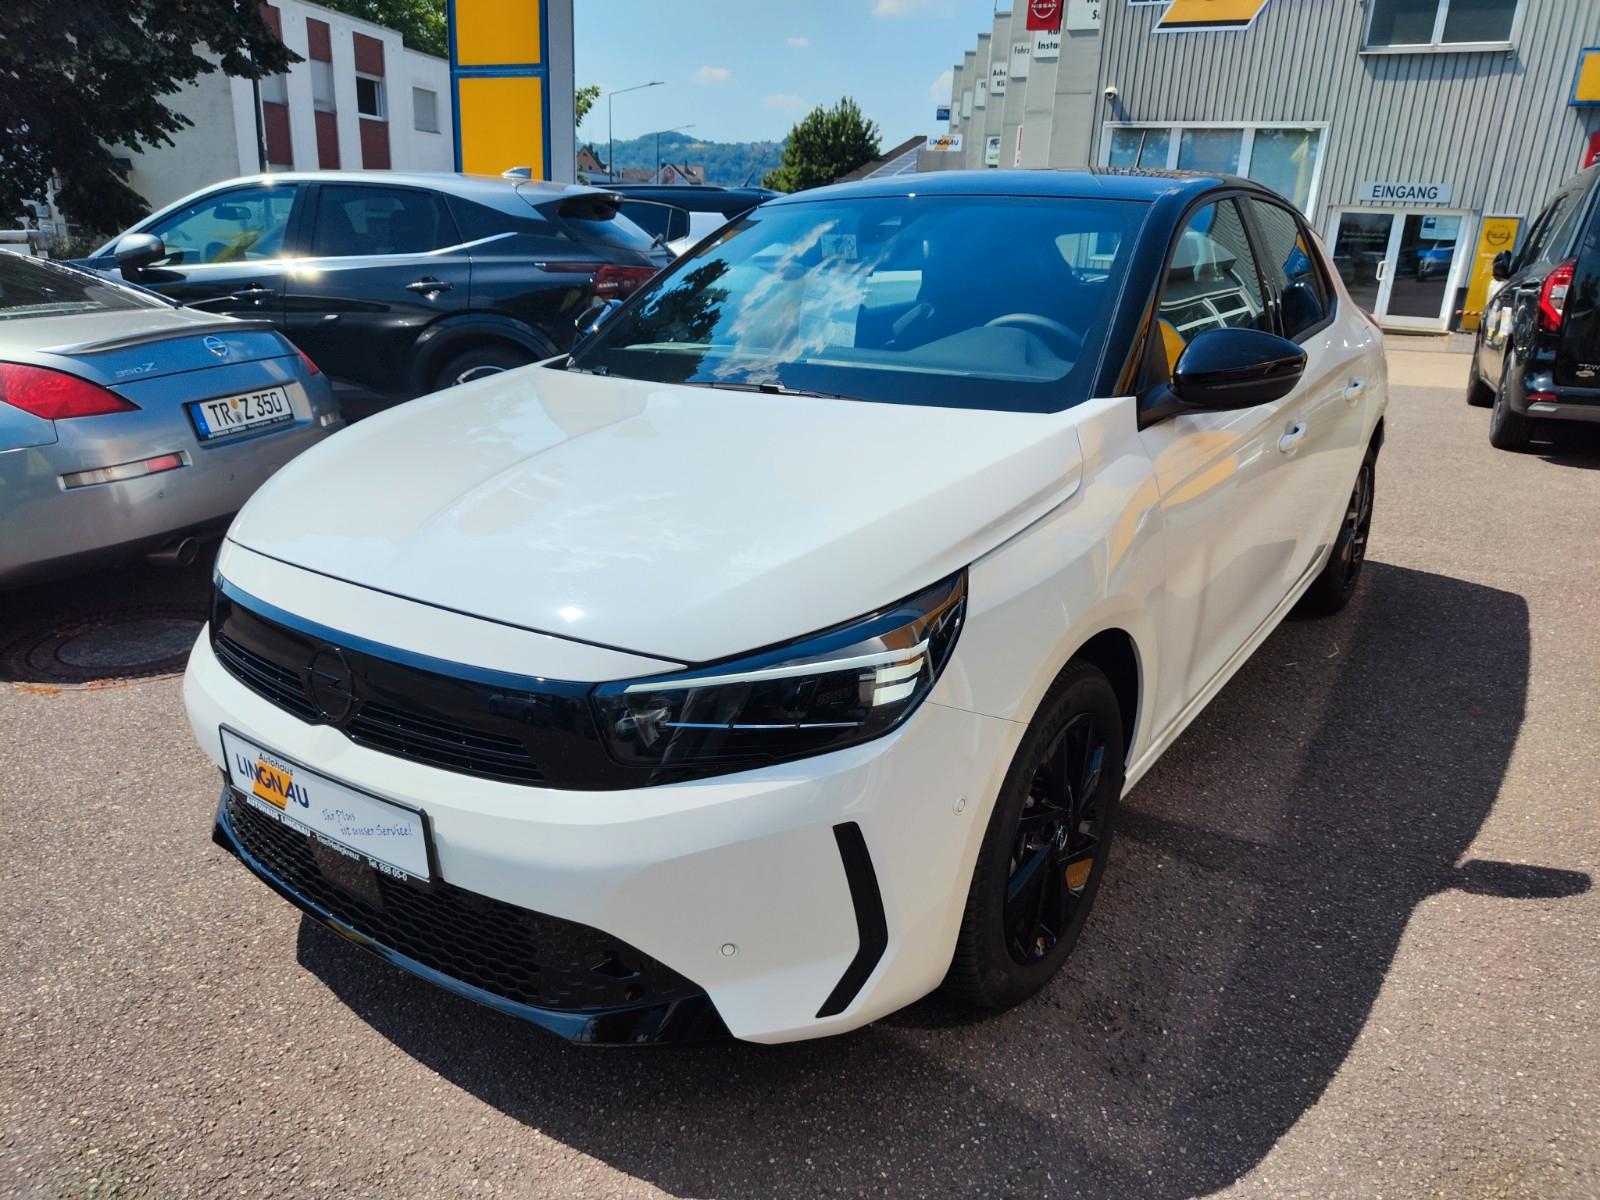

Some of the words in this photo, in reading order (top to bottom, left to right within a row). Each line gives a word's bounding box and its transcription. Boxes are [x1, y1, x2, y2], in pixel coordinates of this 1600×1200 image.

[1037, 41, 1060, 50] Insta
[1371, 184, 1439, 200] EINGANG
[207, 402, 236, 427] TR
[238, 398, 255, 421] Z
[252, 391, 283, 417] 350
[258, 751, 294, 777] Autohaus
[235, 752, 310, 809] LINGNAU
[375, 823, 413, 837] Service!
